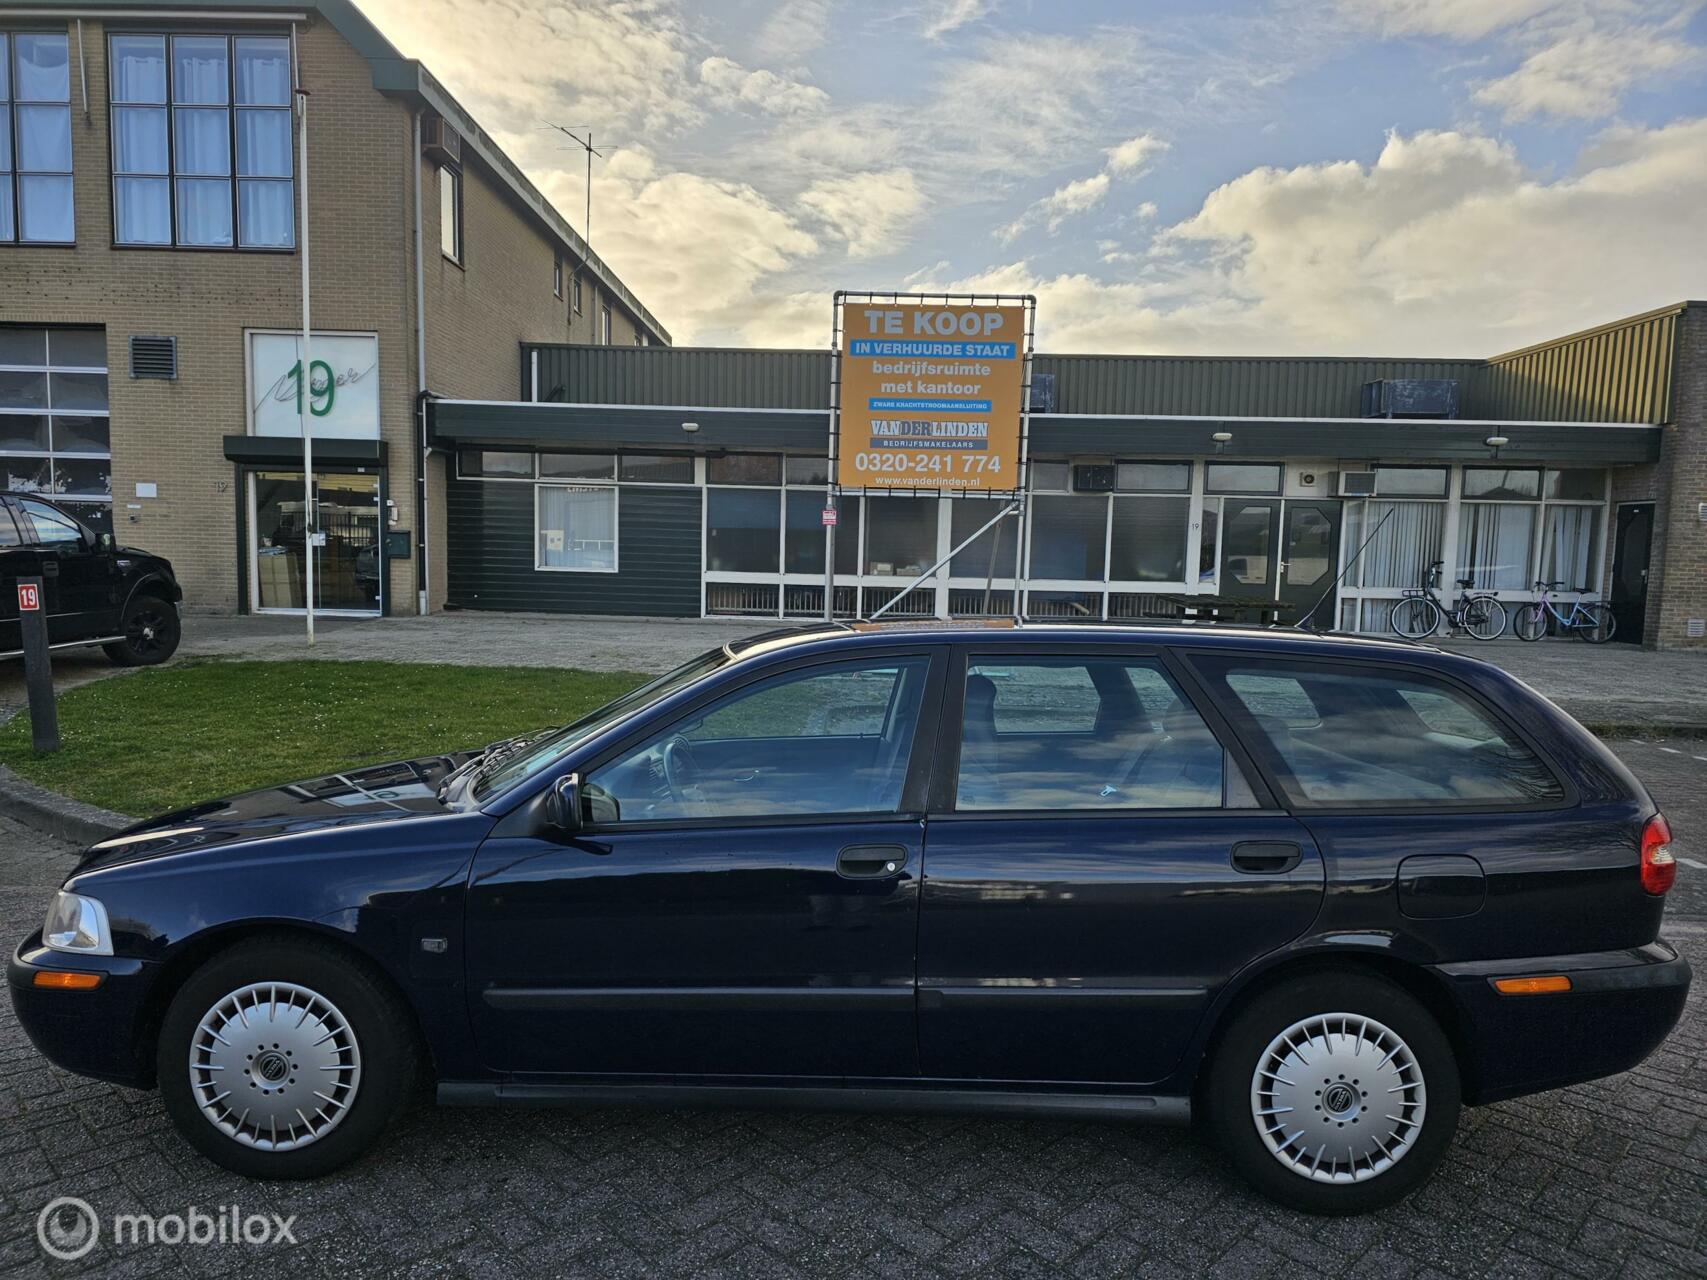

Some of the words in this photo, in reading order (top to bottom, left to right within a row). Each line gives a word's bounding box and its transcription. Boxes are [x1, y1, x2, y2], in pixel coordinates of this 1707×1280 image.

[864, 310, 904, 334] TE
[914, 312, 1004, 336] KOOP
[856, 342, 870, 353] IN
[874, 342, 962, 356] VERHUURDE
[966, 344, 1010, 356] STAAT
[873, 361, 991, 376] bedrijfsruimte
[287, 360, 334, 416] 19
[881, 382, 912, 394] met
[917, 381, 981, 395] kantoor
[871, 421, 988, 437] VANDERLINDEN
[883, 440, 974, 448] BEDRIJFSMAKELAARS
[855, 453, 952, 472] 0320-241
[962, 455, 1001, 473] 774
[875, 476, 980, 487] www.vanderlinden.nl
[21, 589, 35, 605] 19
